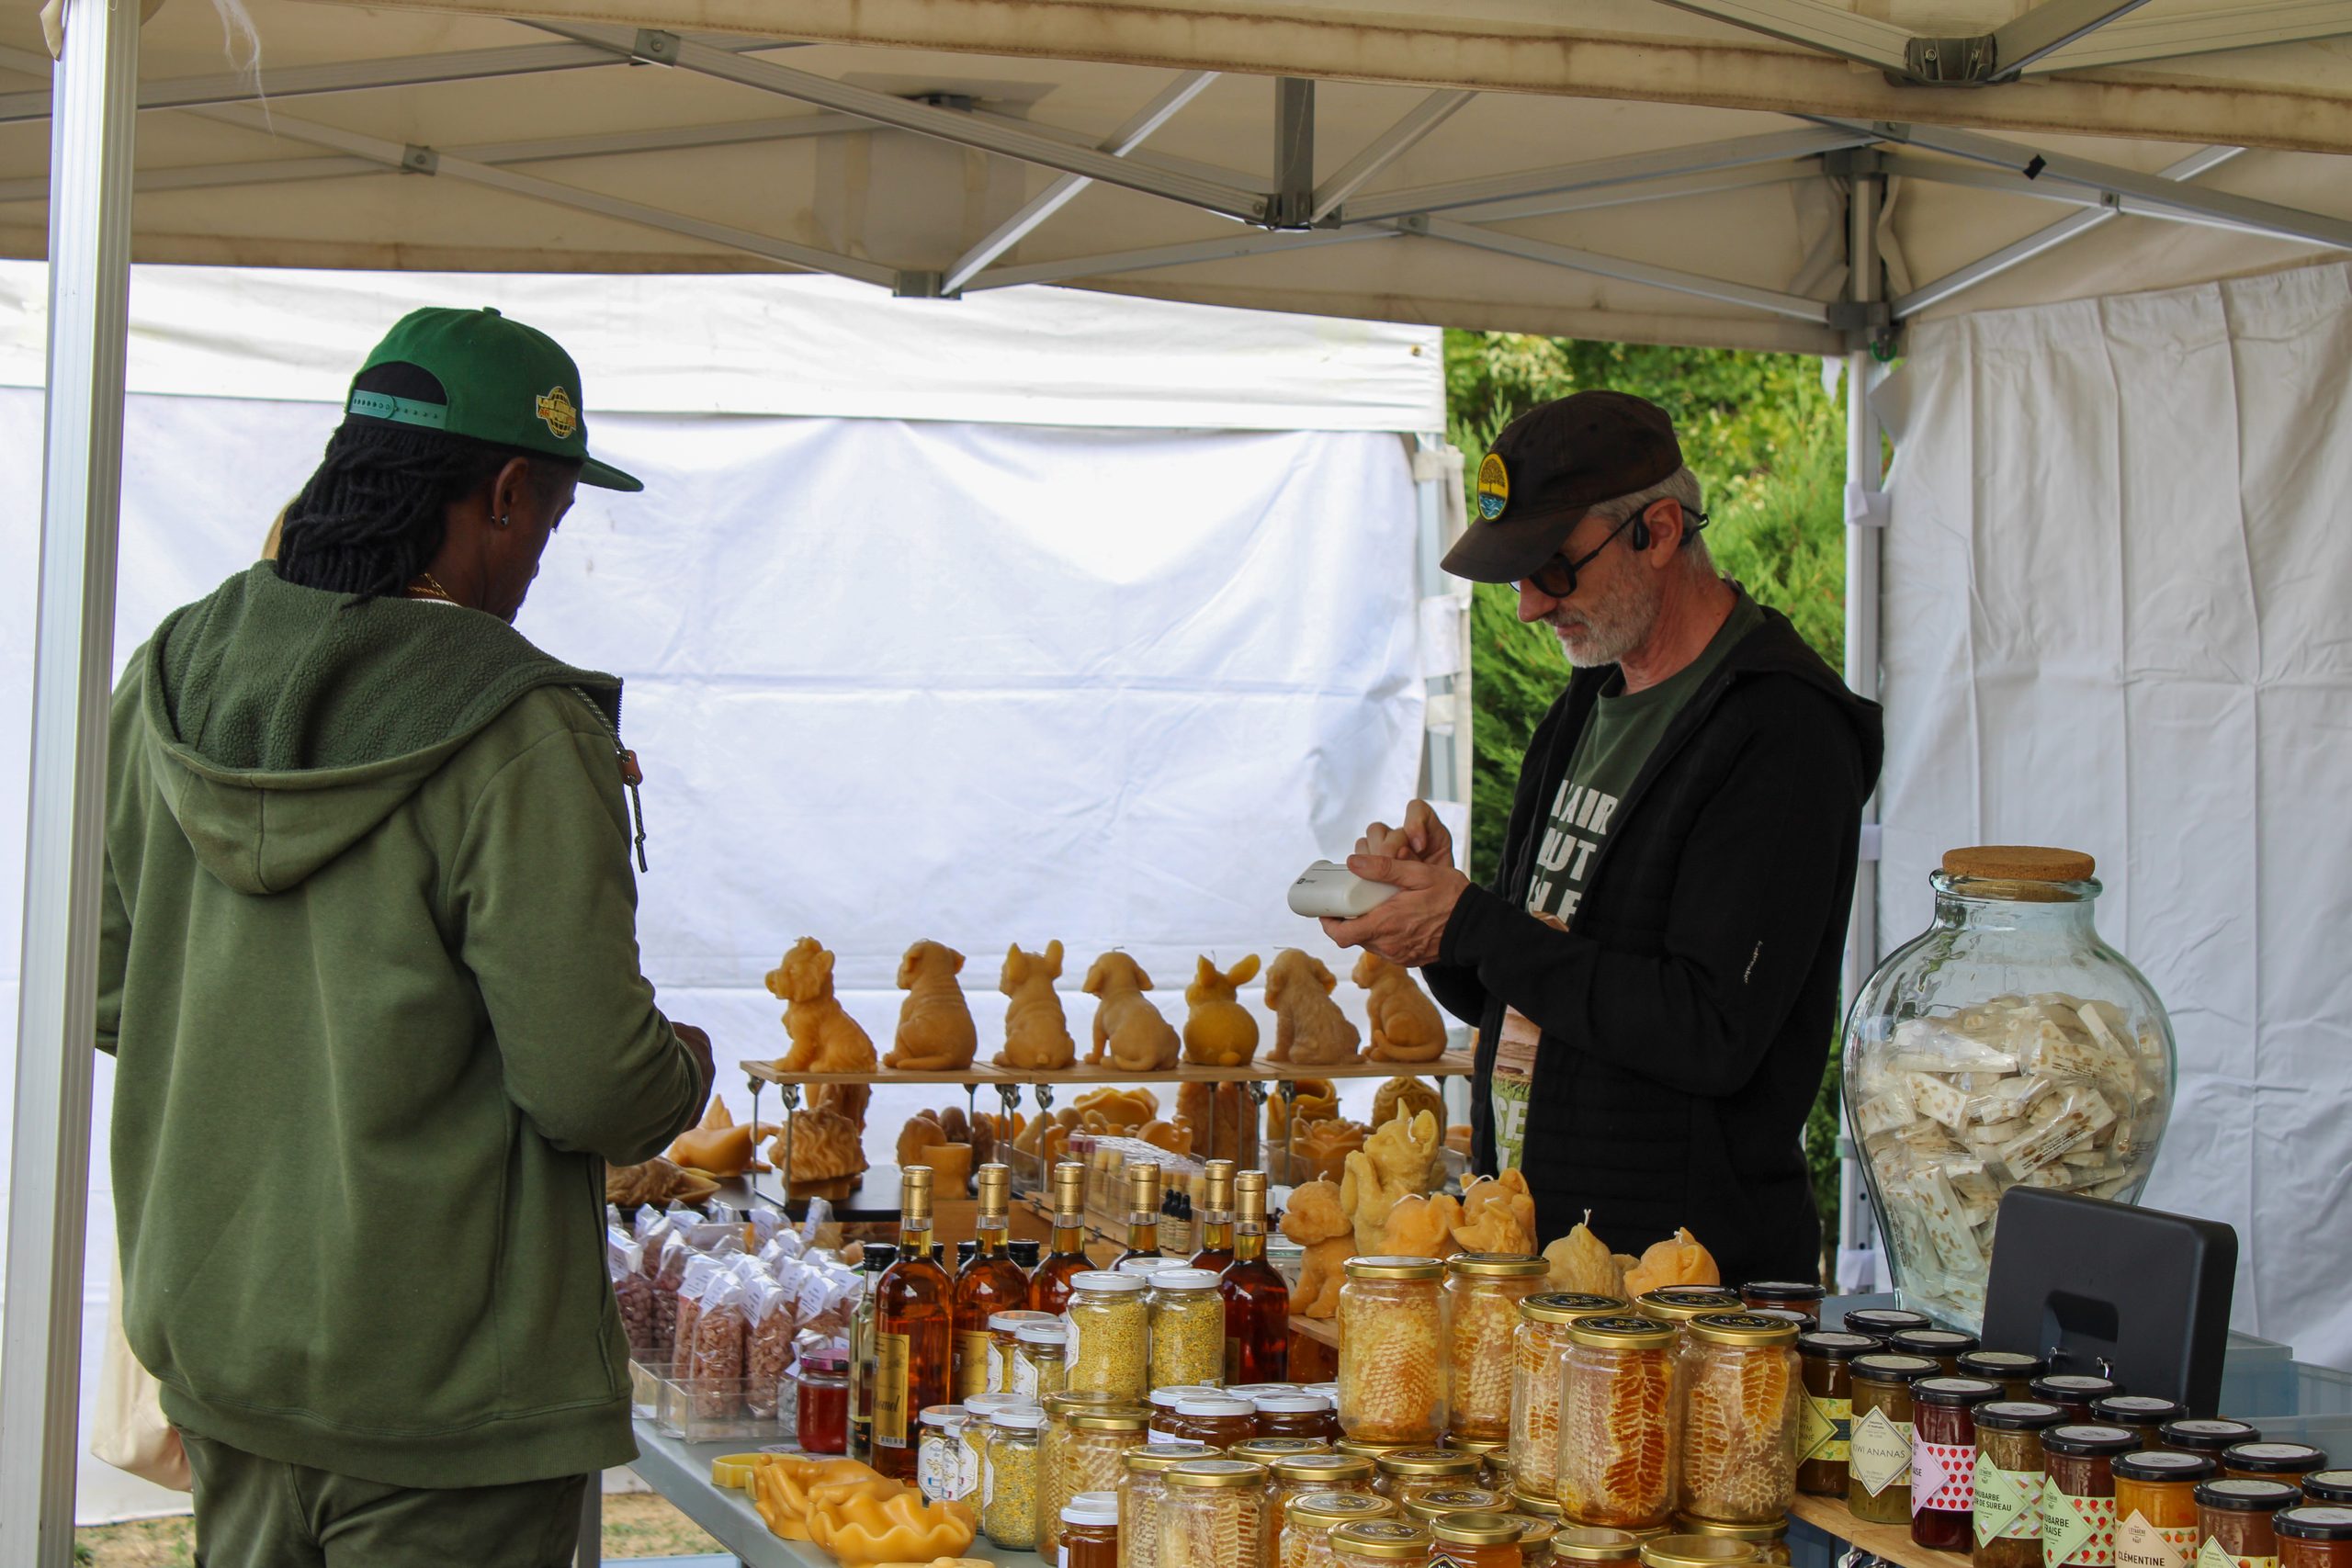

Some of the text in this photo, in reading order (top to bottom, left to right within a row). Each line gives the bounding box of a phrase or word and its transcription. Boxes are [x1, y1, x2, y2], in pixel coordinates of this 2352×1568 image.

[1866, 1448, 1905, 1459] ANANAS
[1979, 1499, 1985, 1507] DE
[1985, 1501, 2012, 1512] SUREAU
[2118, 1551, 2165, 1567] CLÉMENTINE
